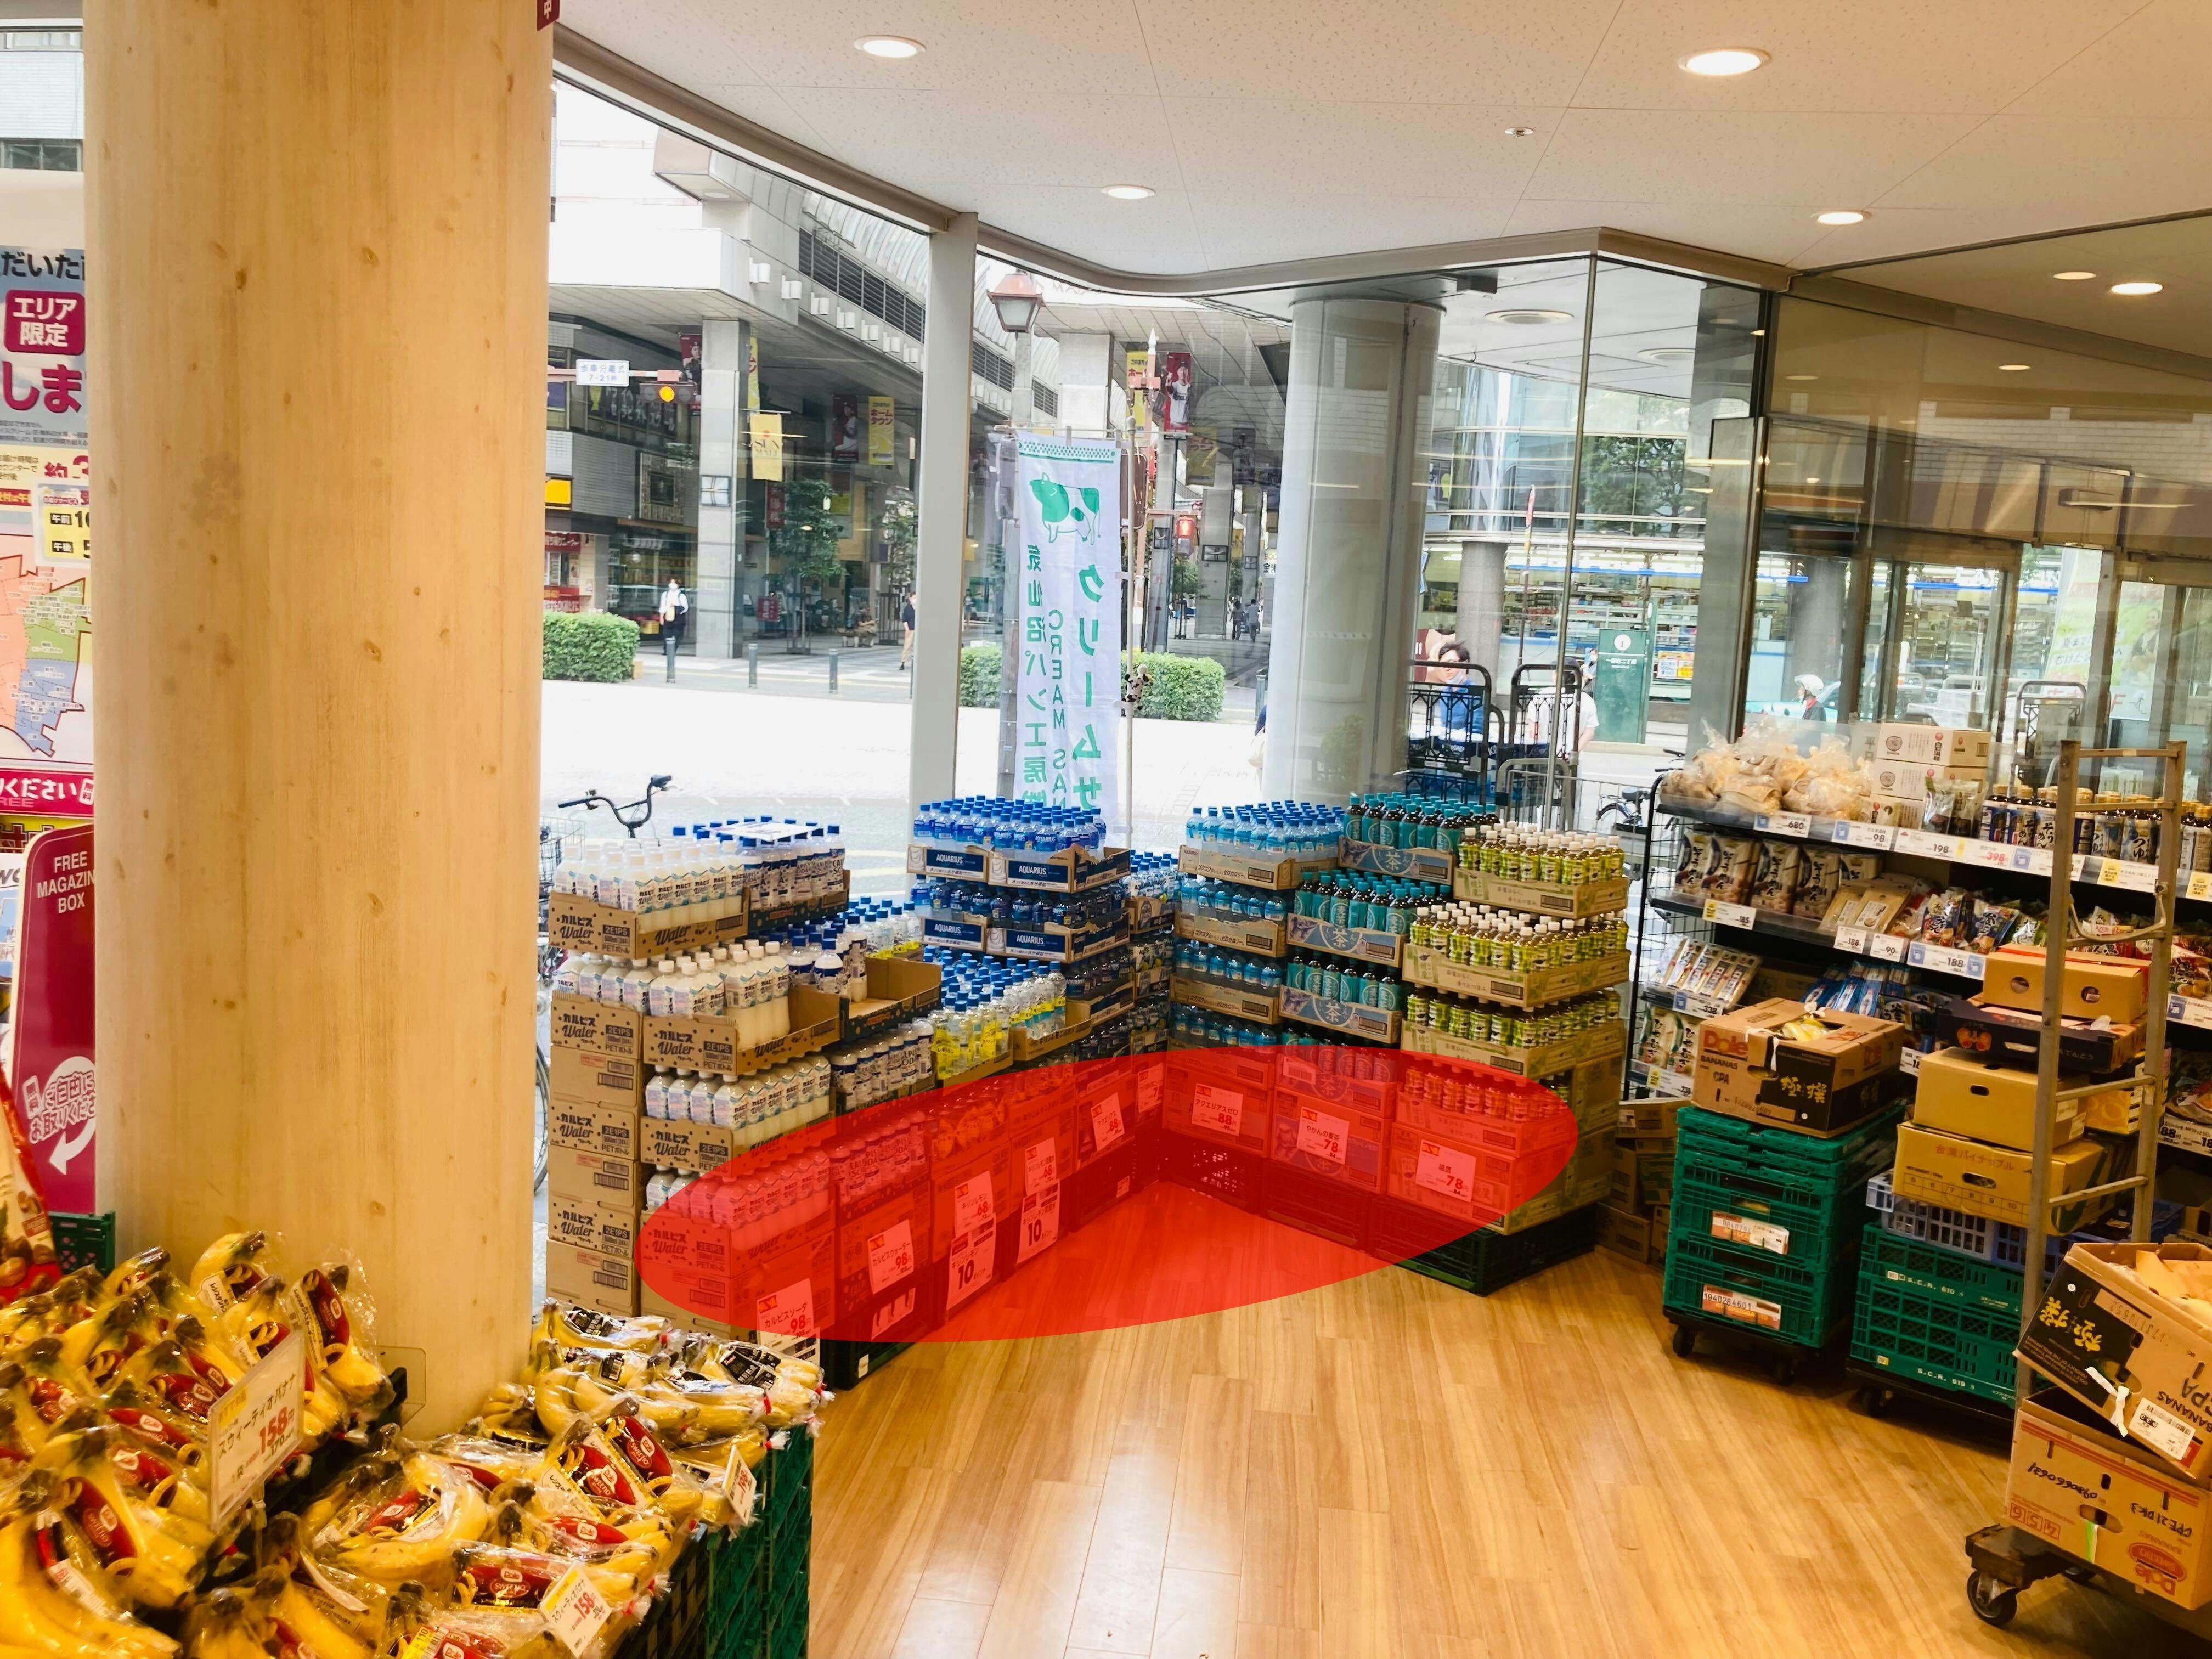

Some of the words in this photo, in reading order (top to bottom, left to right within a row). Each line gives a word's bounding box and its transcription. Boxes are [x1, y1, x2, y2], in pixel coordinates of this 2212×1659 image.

[13, 297, 77, 320] エリア
[19, 321, 69, 347] 限定
[2, 360, 83, 413] しま
[871, 409, 893, 417] ホーム
[52, 514, 71, 524] 午前
[54, 542, 72, 552] 午後
[1788, 821, 1804, 830] 680
[1873, 834, 1886, 843] 98
[1933, 844, 1950, 853] 198
[2133, 838, 2146, 859] つゆ
[54, 851, 87, 873] FREE
[935, 853, 963, 865] AQUARIUS
[1986, 851, 2006, 862] 398
[1018, 865, 1047, 876] AQUARIUS
[58, 892, 85, 913] BOX
[561, 915, 593, 927] カルピス
[1739, 915, 1750, 924] 185
[560, 925, 594, 939] Water
[604, 926, 629, 936] 2E1PS
[654, 924, 691, 946] Water
[934, 923, 962, 935] AQUARIUS
[1015, 934, 1045, 945] AQUARIUS
[1848, 938, 1859, 946] 188
[1947, 957, 1964, 968] 188
[1702, 1006, 1718, 1015] 338
[563, 1013, 596, 1027] カルピス
[562, 1024, 597, 1038] Water
[607, 1025, 632, 1037] 2E1PS
[659, 1030, 693, 1043] カルピス
[658, 1041, 695, 1056] Water
[705, 1042, 731, 1054] 2E1PS
[1703, 1029, 1749, 1056] Dole
[1700, 1056, 1739, 1070] BANANAS
[1712, 1071, 1730, 1085] CPA
[1780, 1075, 1829, 1104] 極撰
[1195, 1098, 1238, 1115] アクエリアスゼロ
[560, 1113, 592, 1127] カルピス
[1097, 1110, 1117, 1129] アクエリアス
[1109, 1118, 1119, 1131] 88
[560, 1124, 593, 1138] Water
[604, 1126, 628, 1137] 2E1PS
[656, 1131, 690, 1145] カルピス
[1306, 1124, 1340, 1142] やかんの麦茶
[655, 1142, 690, 1156] Water
[701, 1143, 726, 1155] 2E1PS
[1936, 1143, 2015, 1172] 台湾パイナップル
[1043, 1164, 1053, 1178] 68
[962, 1193, 987, 1209] キリンレモン
[977, 1200, 988, 1217] 68
[562, 1210, 594, 1225] カルピス
[561, 1222, 594, 1237] Water
[604, 1226, 629, 1238] 2E1PS
[653, 1228, 687, 1244] カルピス
[1027, 1218, 1042, 1247] 10
[652, 1240, 689, 1255] Water
[698, 1243, 723, 1254] 2E1PS
[872, 1242, 911, 1266] カルピスウォーター
[895, 1252, 907, 1269] 98
[951, 1248, 979, 1268] キリンレモン
[957, 1259, 975, 1290] 10
[764, 1302, 808, 1328] カルピスソーダ
[790, 1314, 806, 1333] 98
[219, 1372, 296, 1457] スウィーティオバナナ
[630, 1443, 650, 1465] SWEETIO
[640, 1436, 656, 1458] Dole
[603, 1464, 617, 1486] Dole
[578, 1523, 597, 1541] Dole
[503, 1568, 523, 1583] Dole
[2134, 1563, 2176, 1596] Dole
[552, 1577, 586, 1622] スウィーティオバナナ
[573, 1592, 596, 1621] 158
